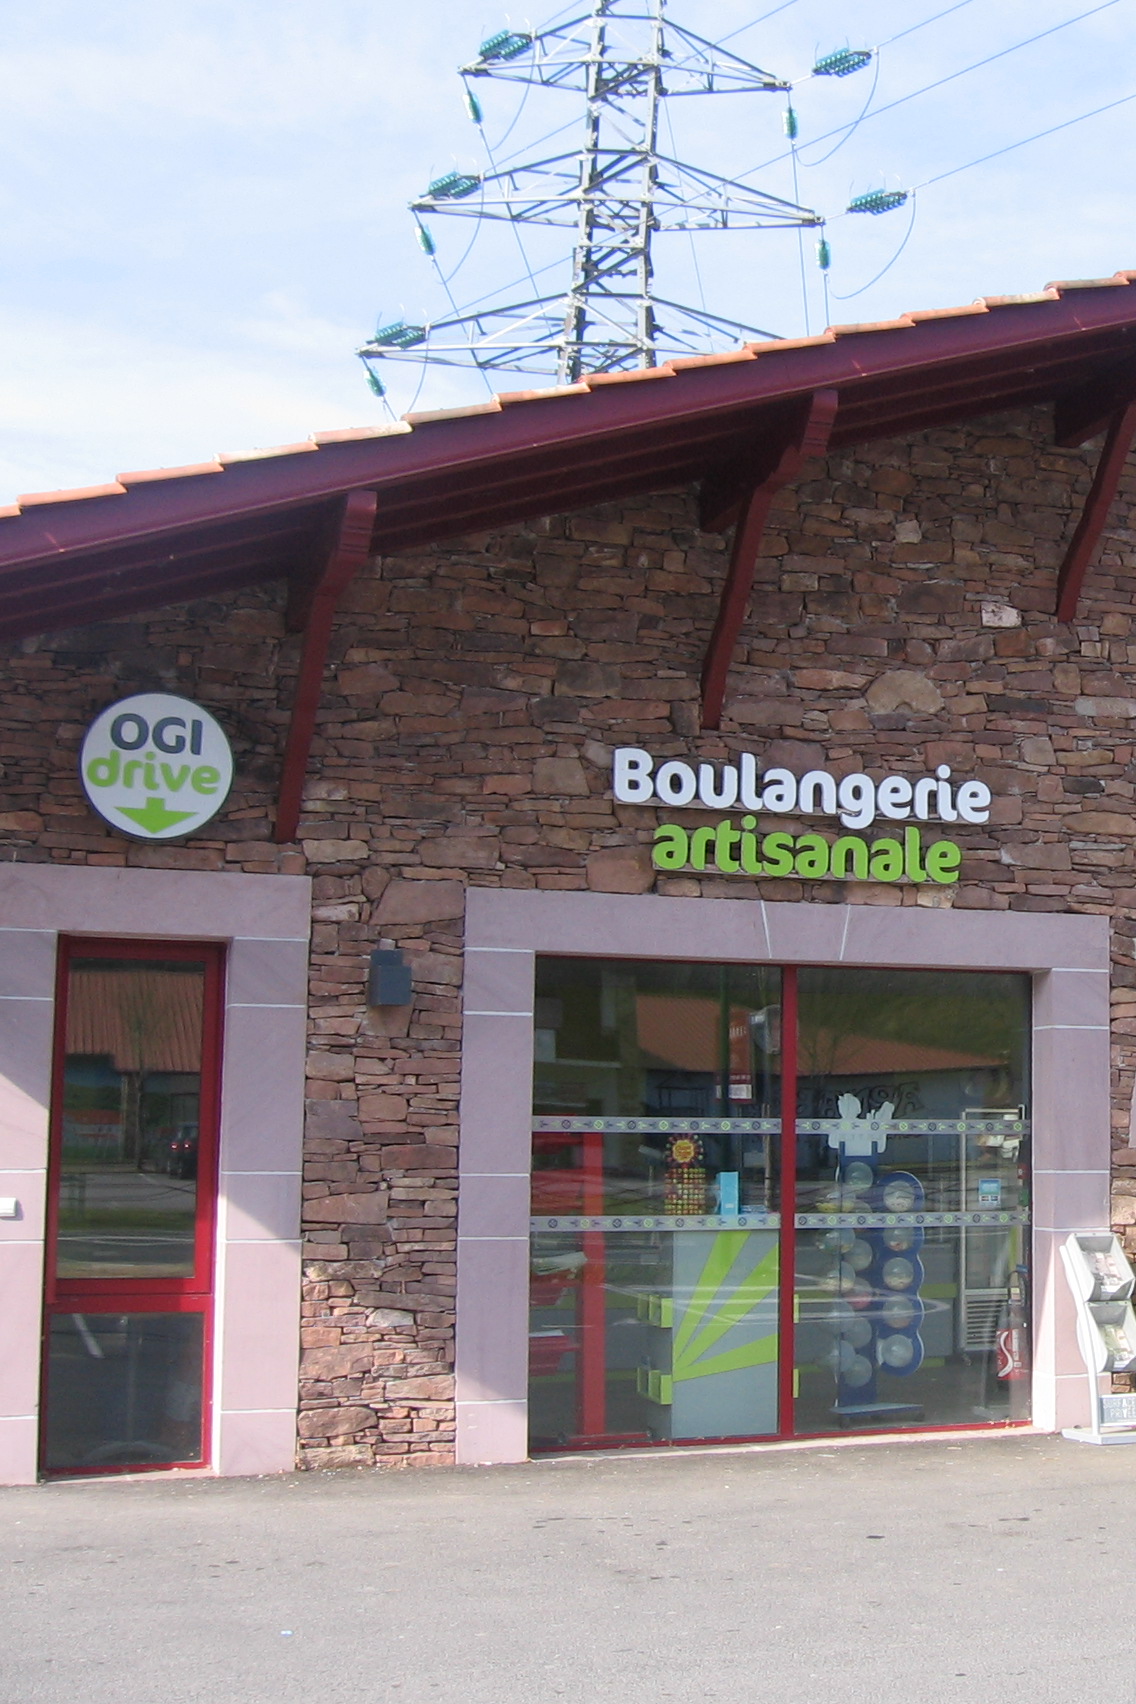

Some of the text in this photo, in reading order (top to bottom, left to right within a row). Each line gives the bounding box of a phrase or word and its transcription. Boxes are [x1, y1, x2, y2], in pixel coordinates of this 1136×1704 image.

[110, 713, 203, 755] OGI
[87, 749, 221, 795] drive
[612, 747, 992, 830] Boulangerie
[652, 814, 962, 884] artisanale
